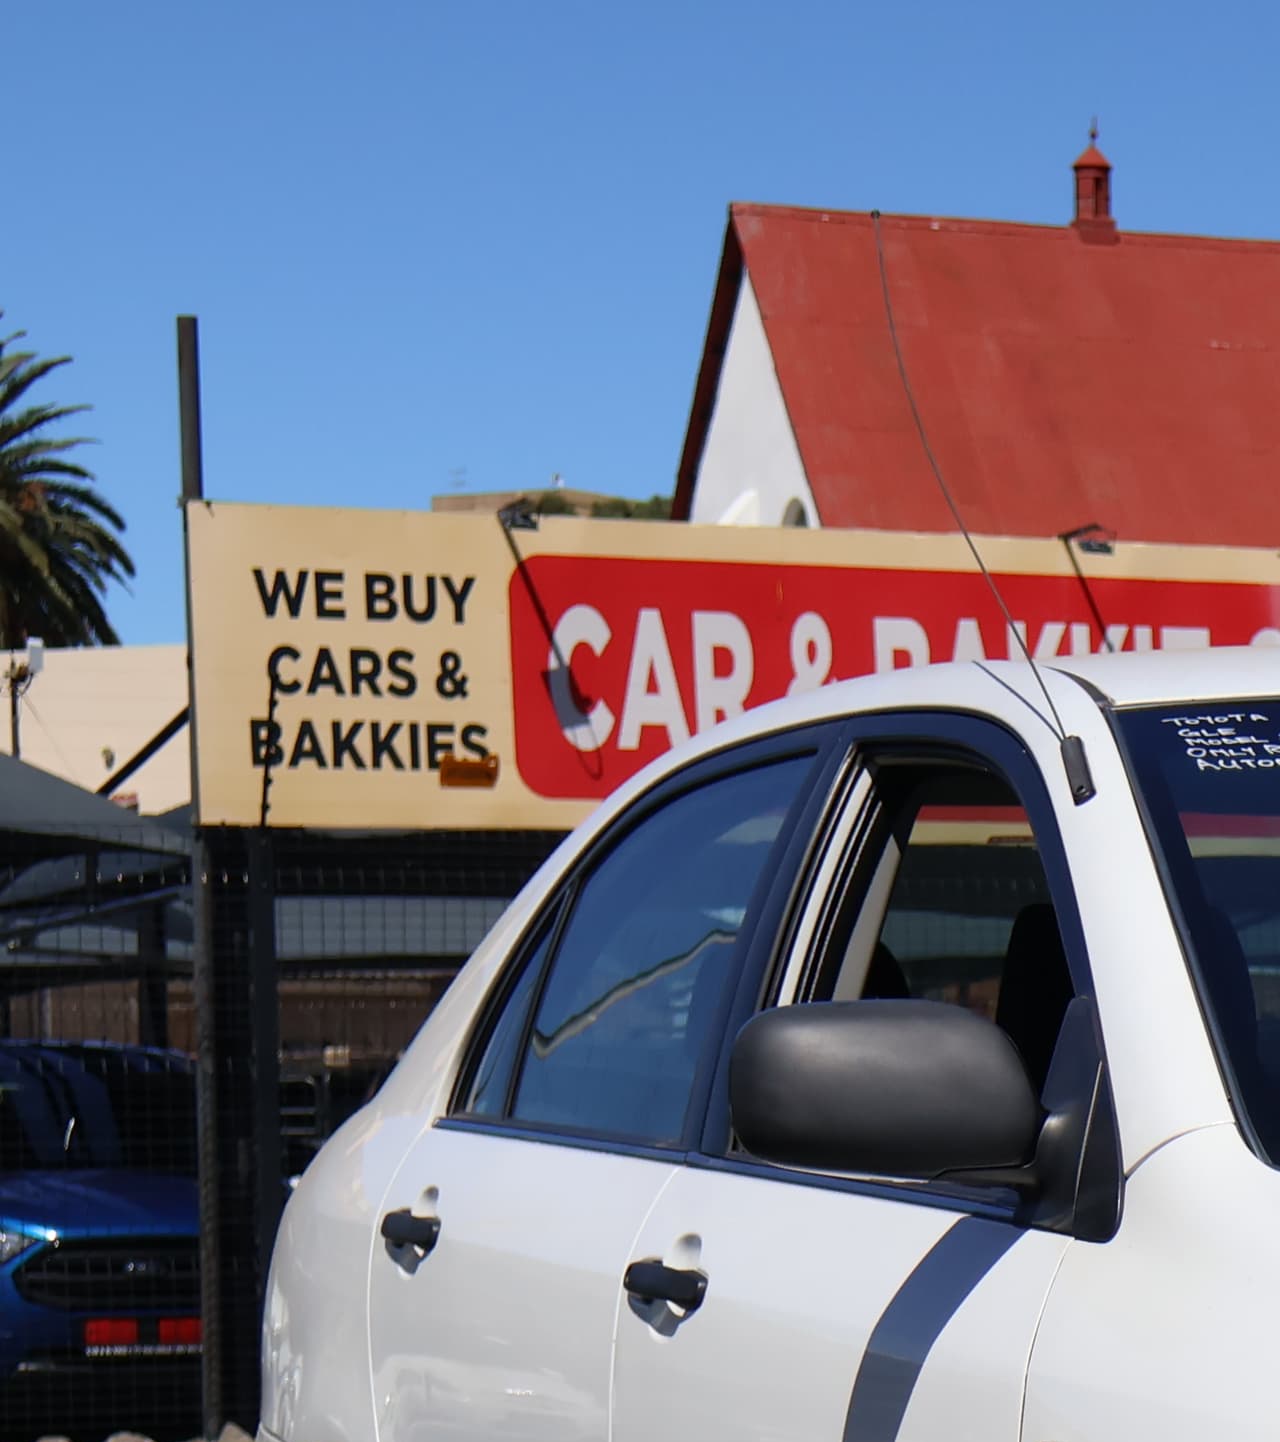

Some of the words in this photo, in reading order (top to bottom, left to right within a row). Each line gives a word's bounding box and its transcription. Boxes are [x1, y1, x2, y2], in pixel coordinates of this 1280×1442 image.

[252, 568, 346, 620] WE
[364, 572, 476, 625] BUY
[267, 645, 418, 698] CARS
[436, 650, 468, 699] &
[548, 603, 754, 752] CAR
[250, 717, 489, 770] BAKKIES
[1161, 713, 1269, 728] TOYOTA
[1178, 726, 1237, 739] GLE
